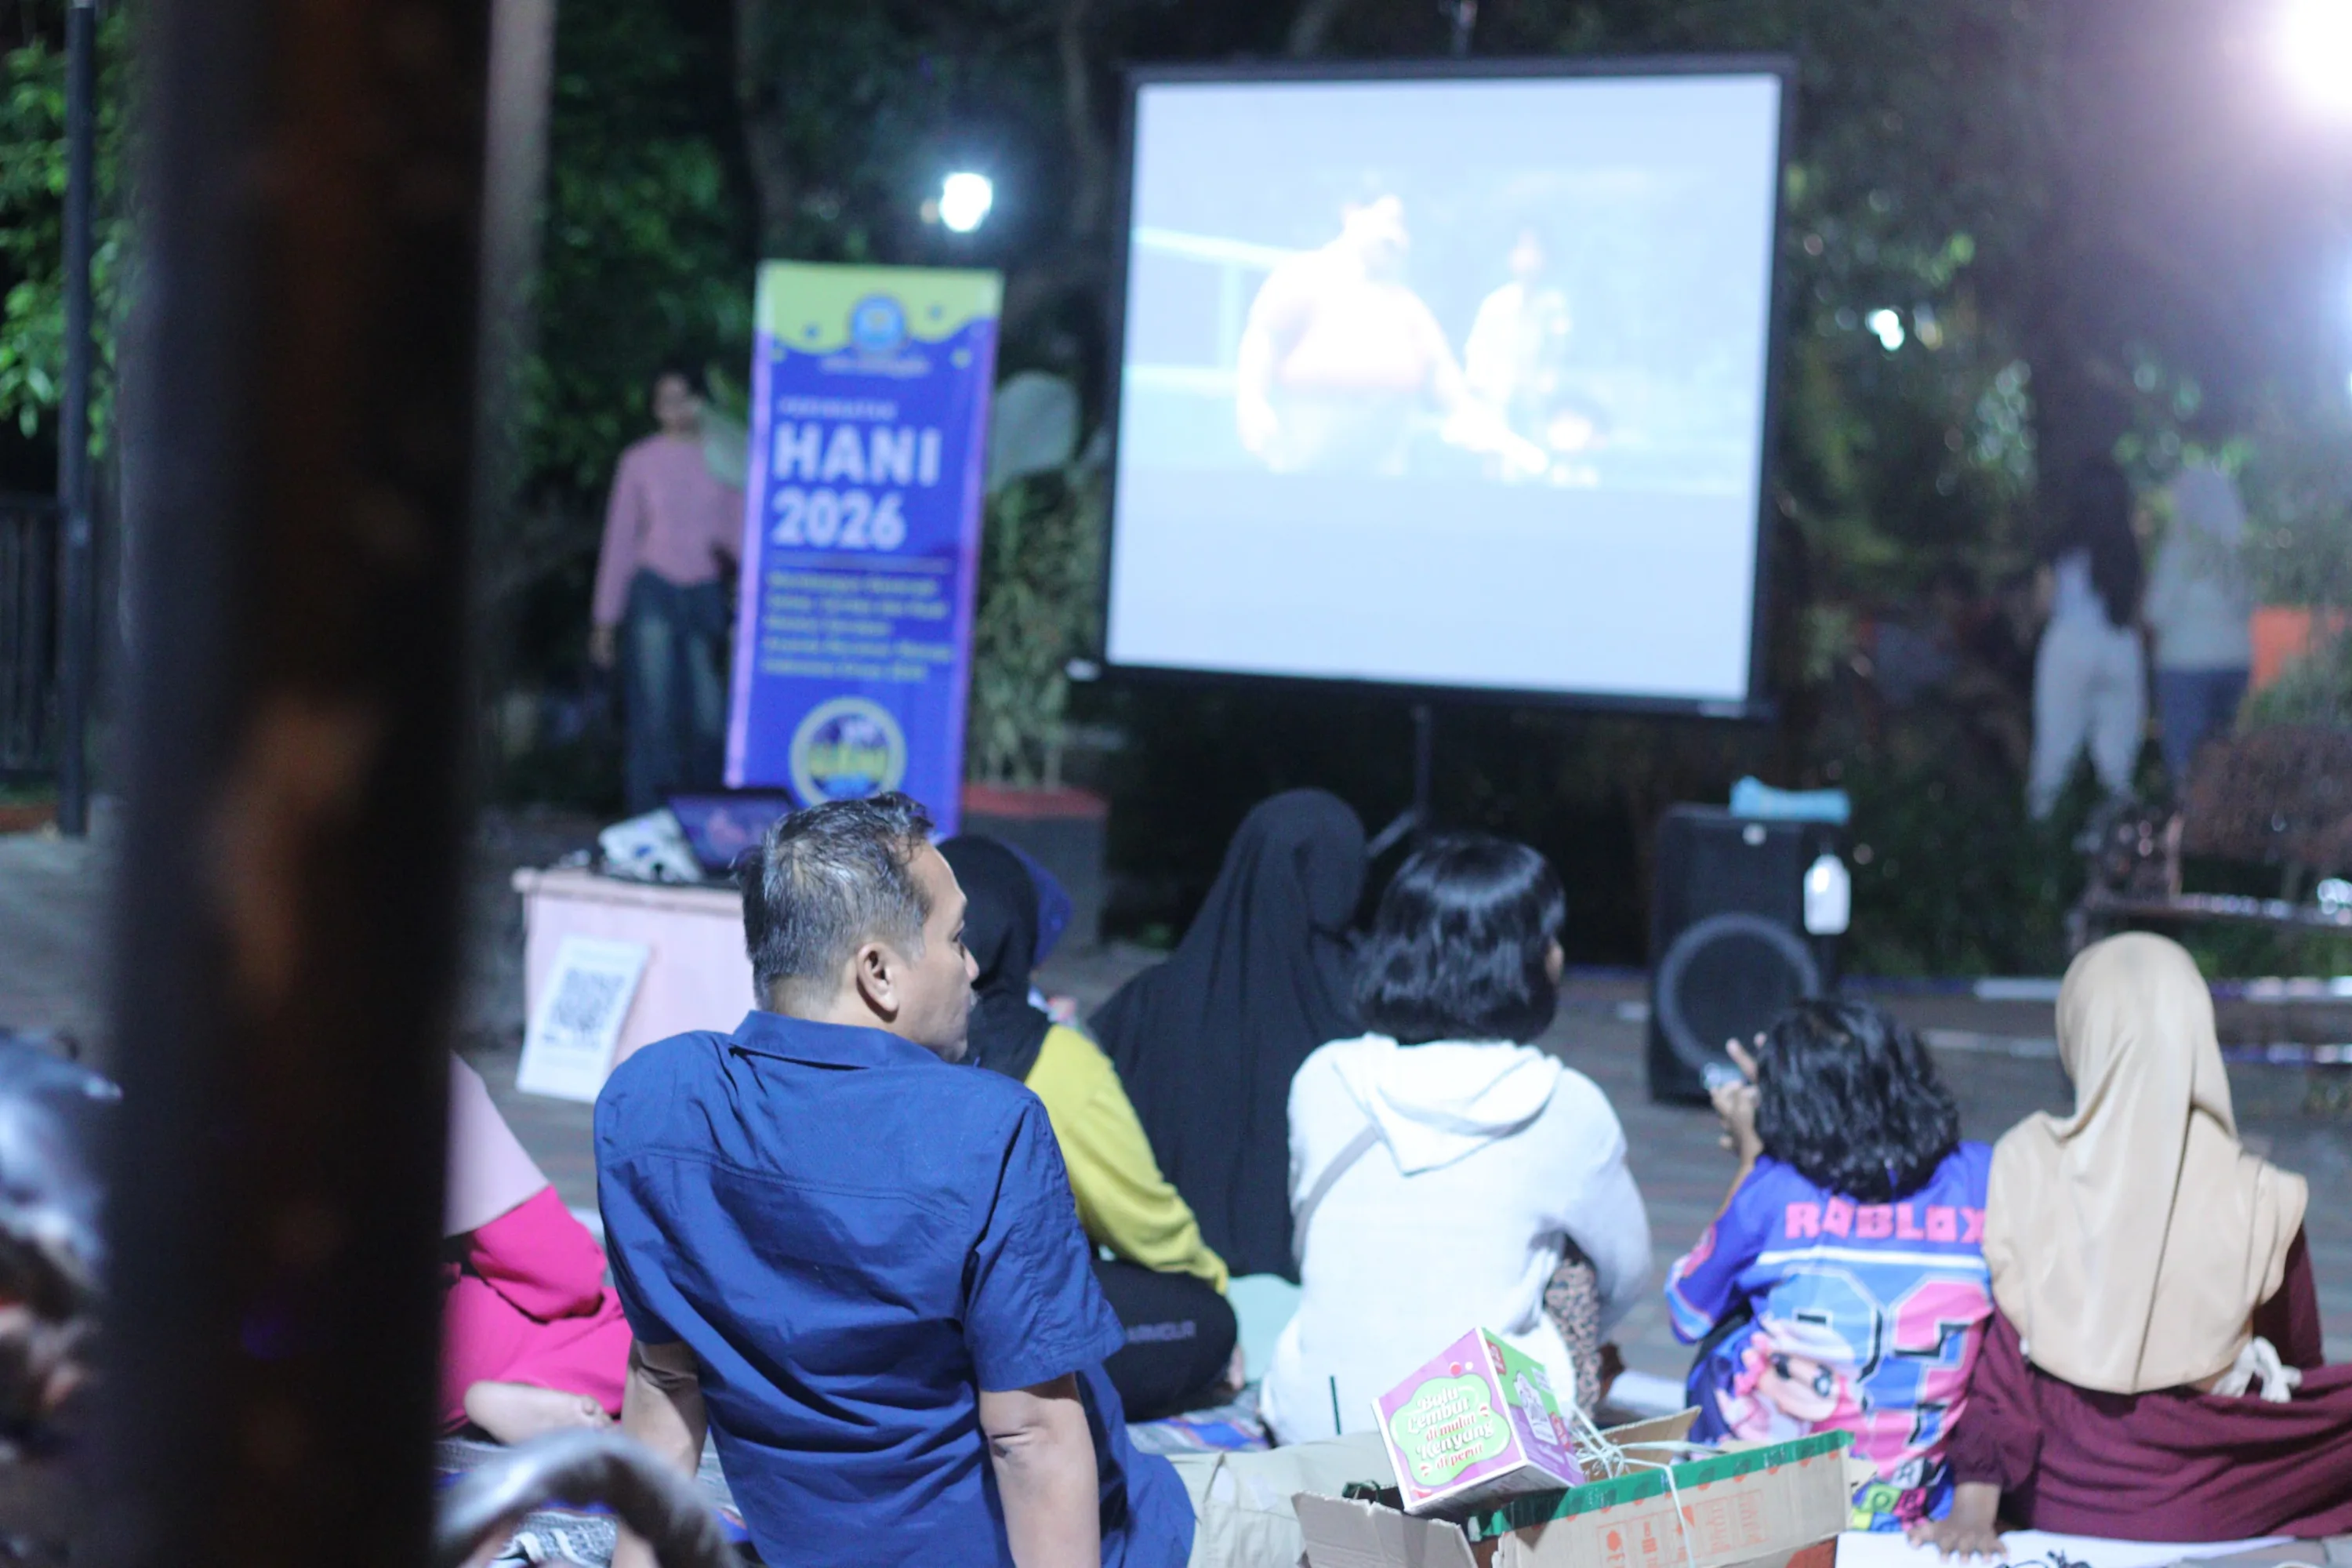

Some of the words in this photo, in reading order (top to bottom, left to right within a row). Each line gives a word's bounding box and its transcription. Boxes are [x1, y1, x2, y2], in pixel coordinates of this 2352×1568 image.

[772, 422, 941, 487] HANI
[771, 486, 906, 550] 2026
[1785, 1197, 1986, 1243] ROBLOX
[1408, 1397, 1470, 1433] Lembut
[1416, 1386, 1460, 1410] Bolu
[1416, 1420, 1494, 1460] Kenyang
[1426, 1426, 1438, 1442] di
[1439, 1414, 1476, 1436] mulut
[1437, 1454, 1448, 1468] di
[1450, 1444, 1483, 1466] perut
